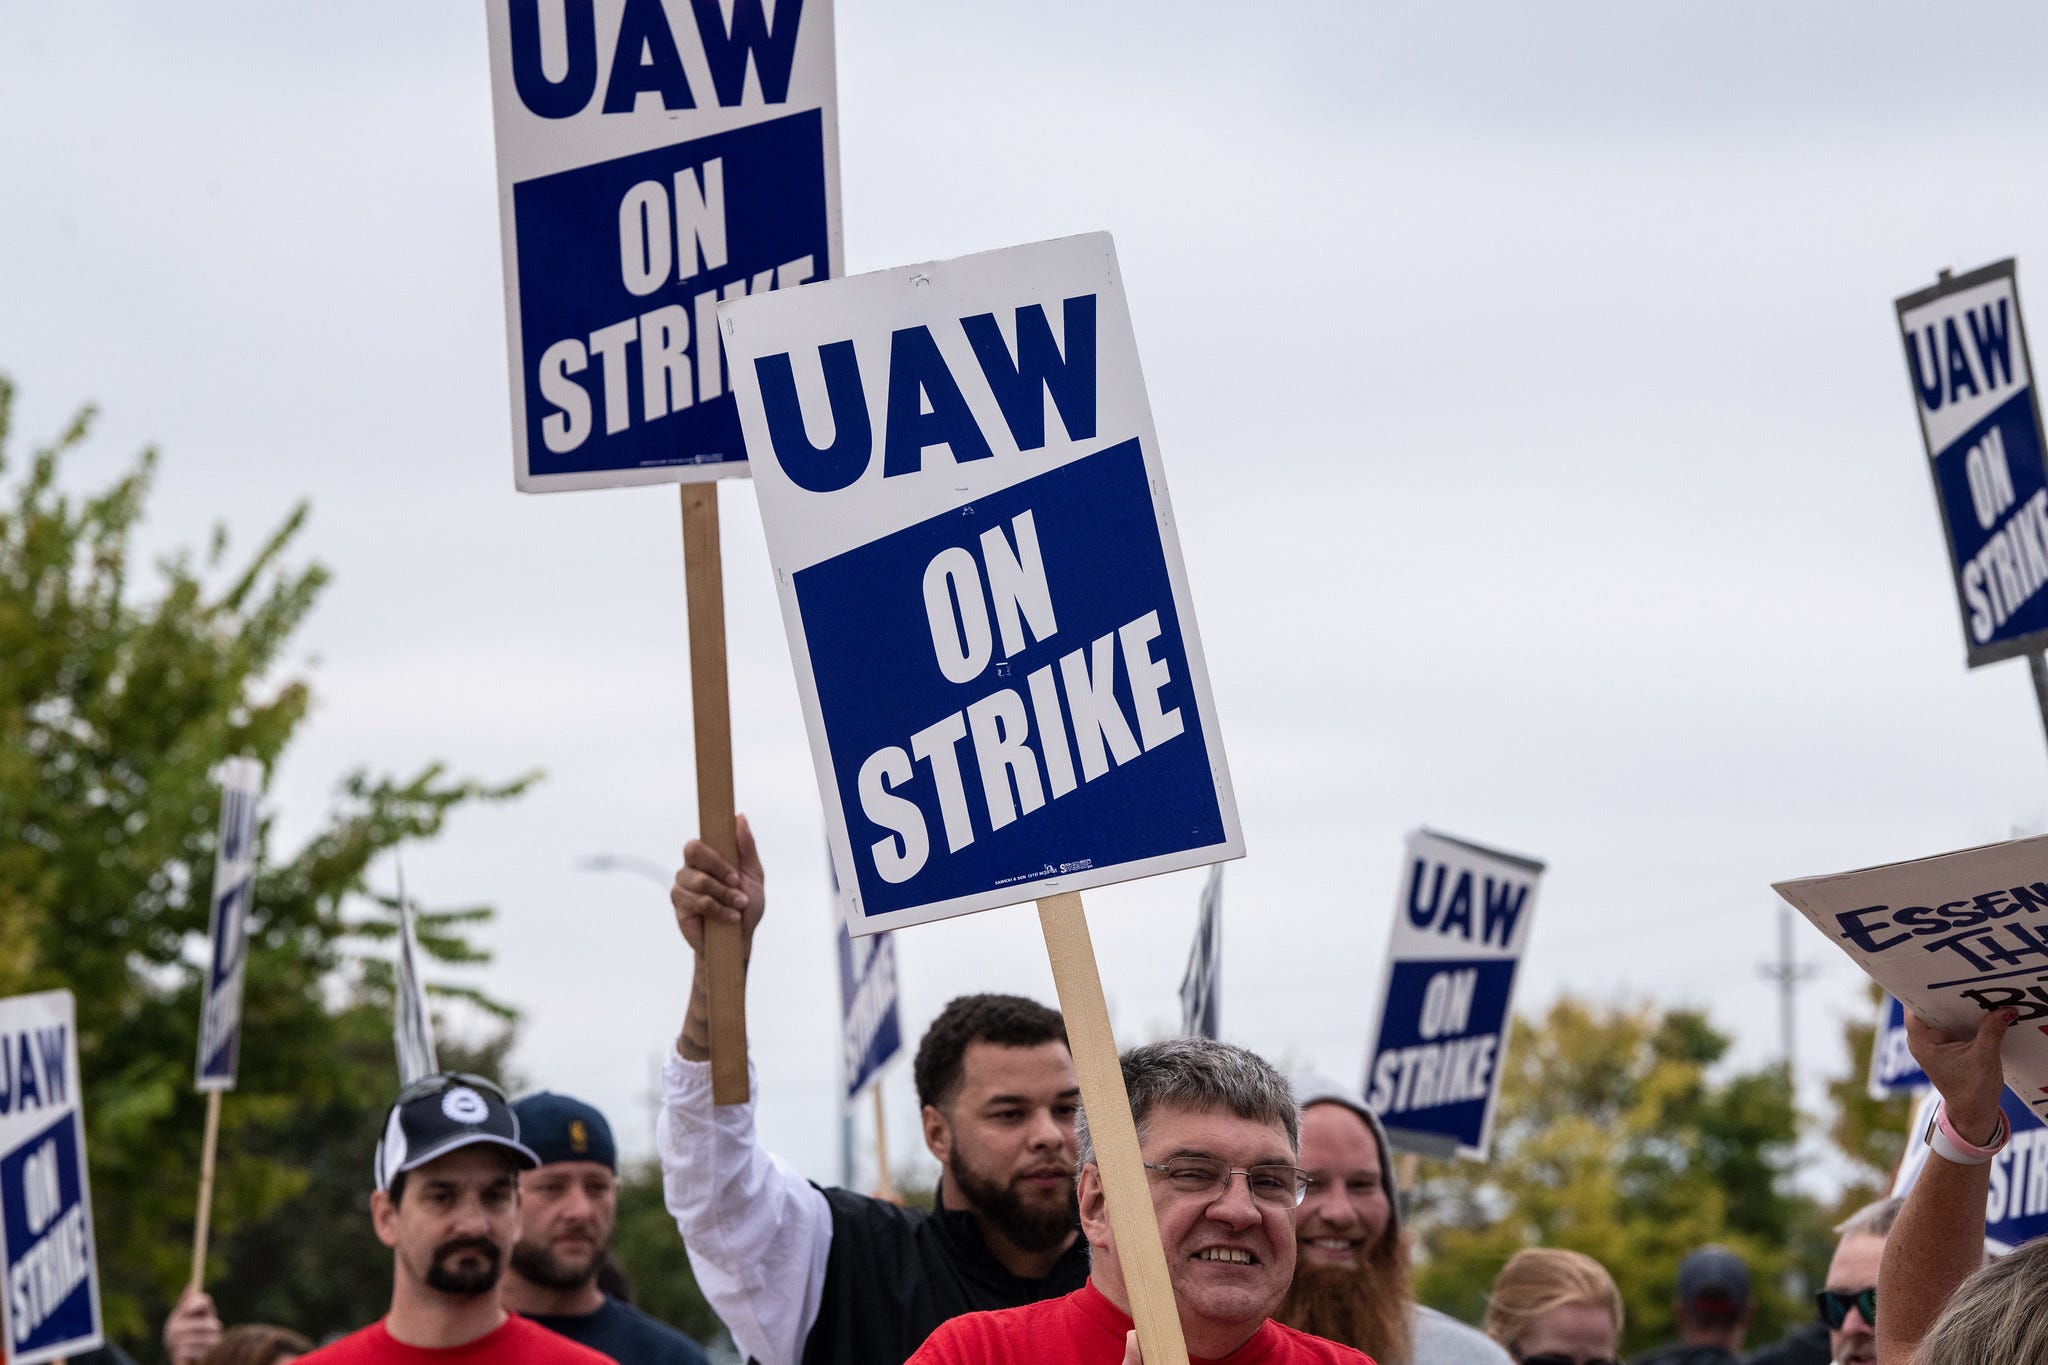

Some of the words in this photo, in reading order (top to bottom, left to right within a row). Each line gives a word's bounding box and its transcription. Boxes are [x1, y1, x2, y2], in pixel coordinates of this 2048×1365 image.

[508, 0, 803, 119] UAW
[619, 156, 728, 297] ON
[754, 294, 1097, 493] UAW
[1906, 298, 2013, 411] UAW
[1965, 424, 2016, 531] ON
[922, 508, 1058, 684] ON
[857, 608, 1185, 885] STRIKE
[1409, 858, 1528, 947] UAW
[1419, 969, 1477, 1039] ON
[1370, 1034, 1495, 1115] STRIKE
[22, 1136, 62, 1236] ON
[9, 1201, 87, 1345] STRIKE
